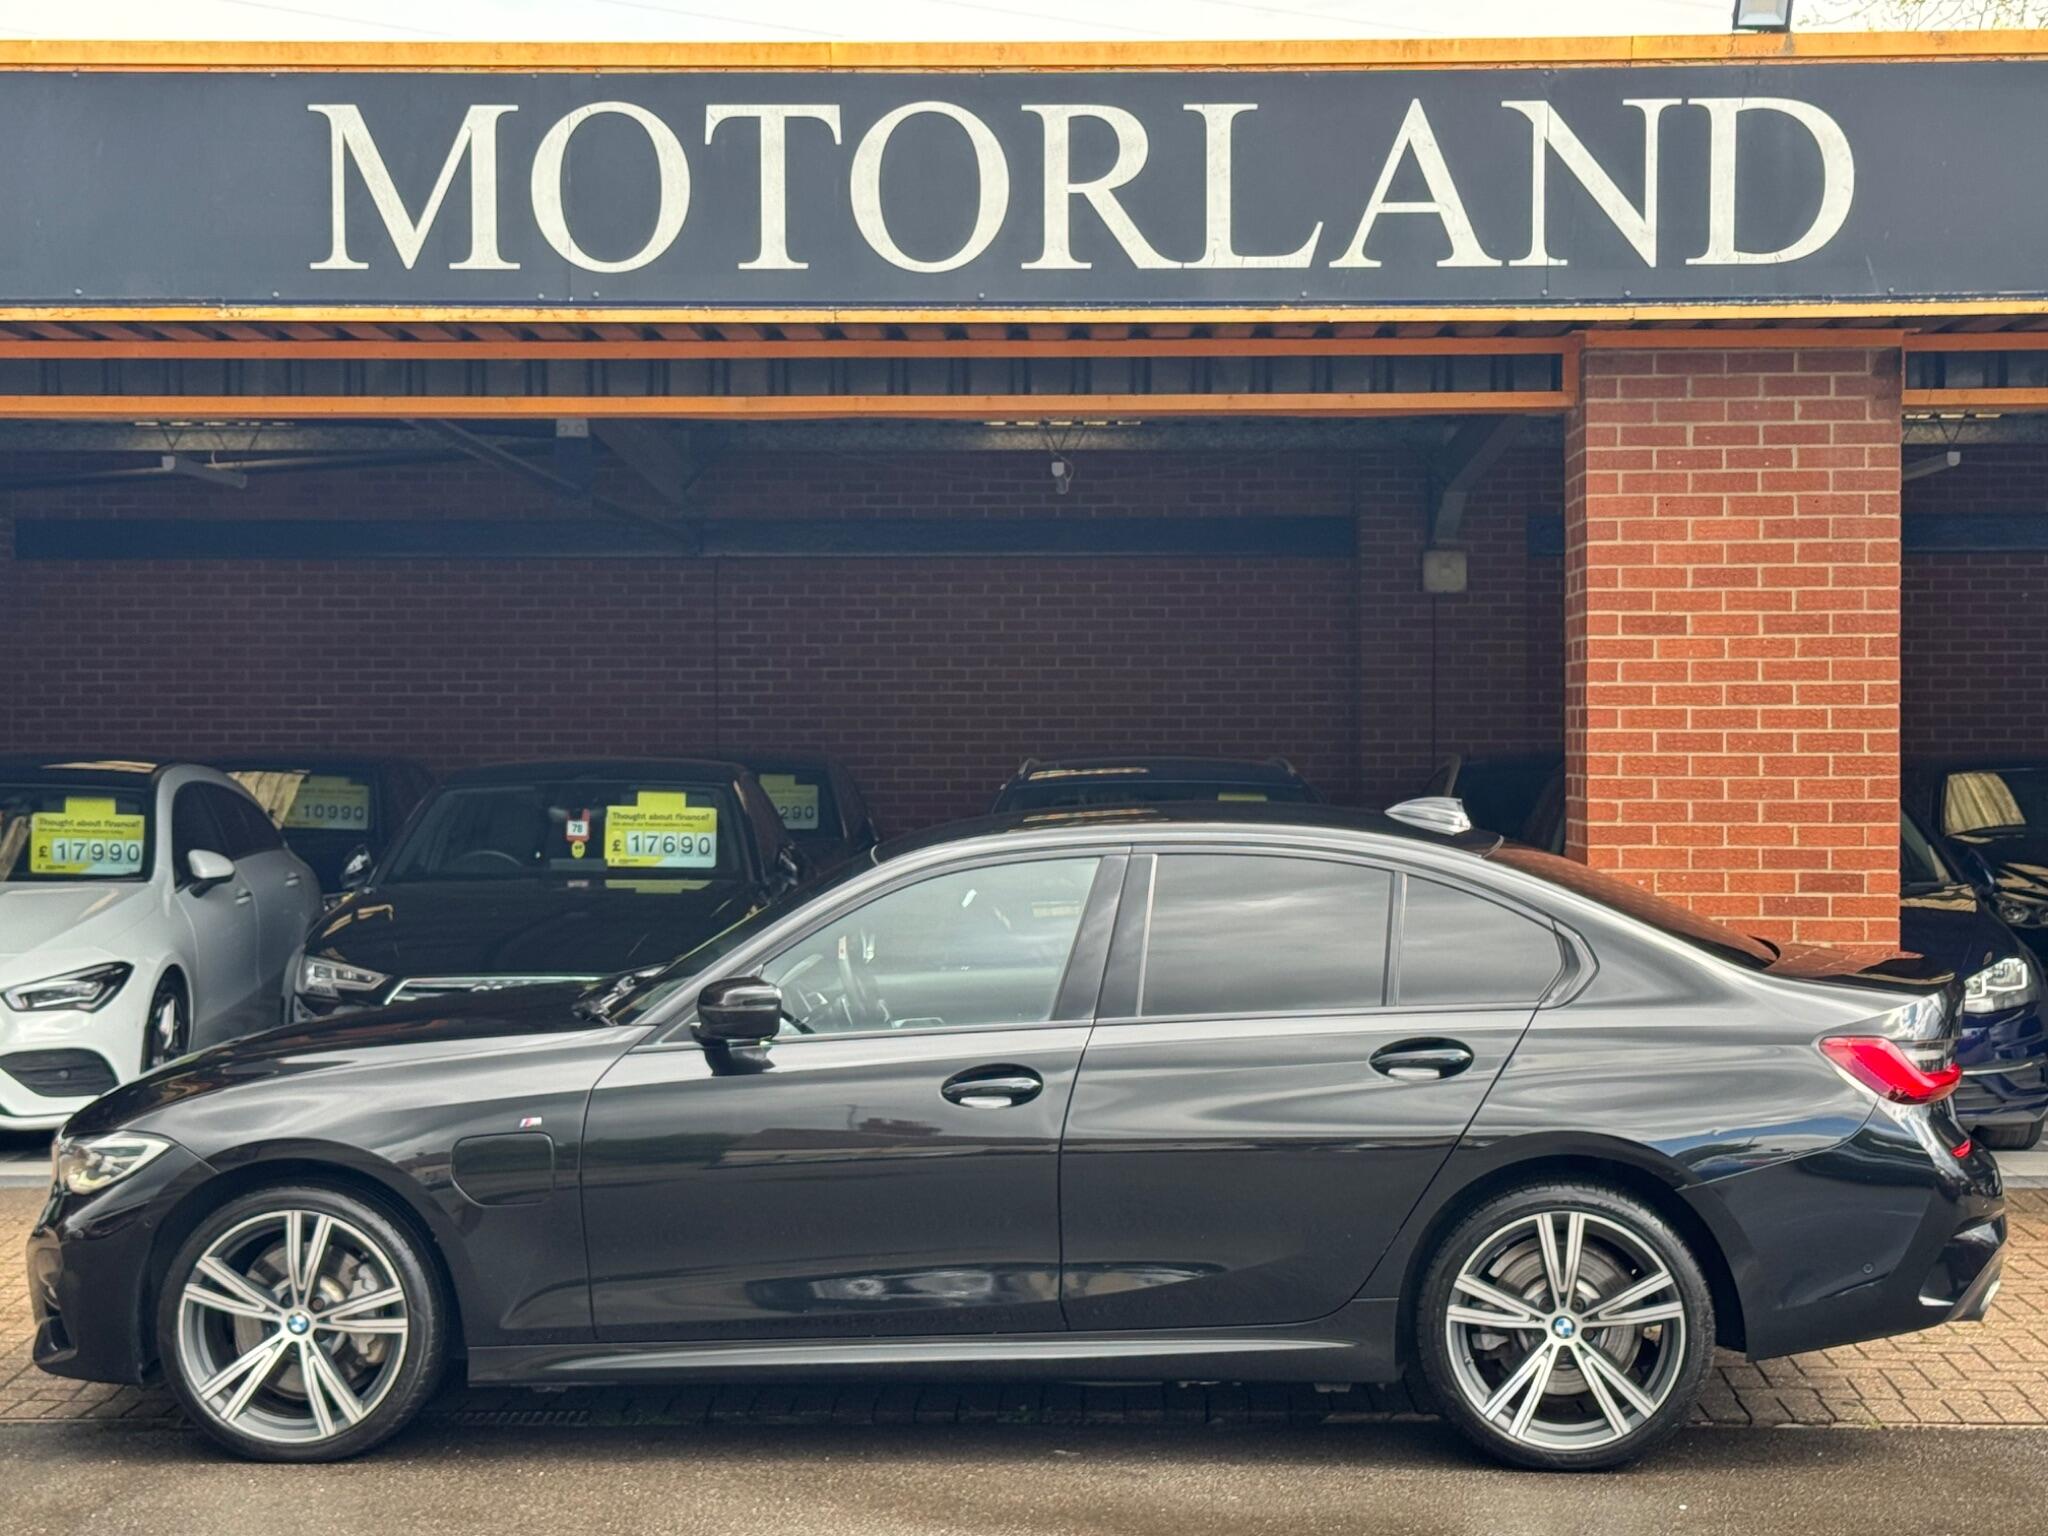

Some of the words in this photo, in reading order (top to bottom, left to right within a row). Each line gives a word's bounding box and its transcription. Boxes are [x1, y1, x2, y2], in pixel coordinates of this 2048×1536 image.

[308, 98, 1854, 273] MOTORLAND
[304, 804, 364, 820] 10990
[612, 812, 646, 821] Thought
[649, 813, 673, 821] about
[675, 813, 710, 822] finance?
[38, 817, 74, 828] Thought
[76, 820, 101, 828] about
[57, 843, 140, 862] 17990
[631, 835, 711, 855] 17690
